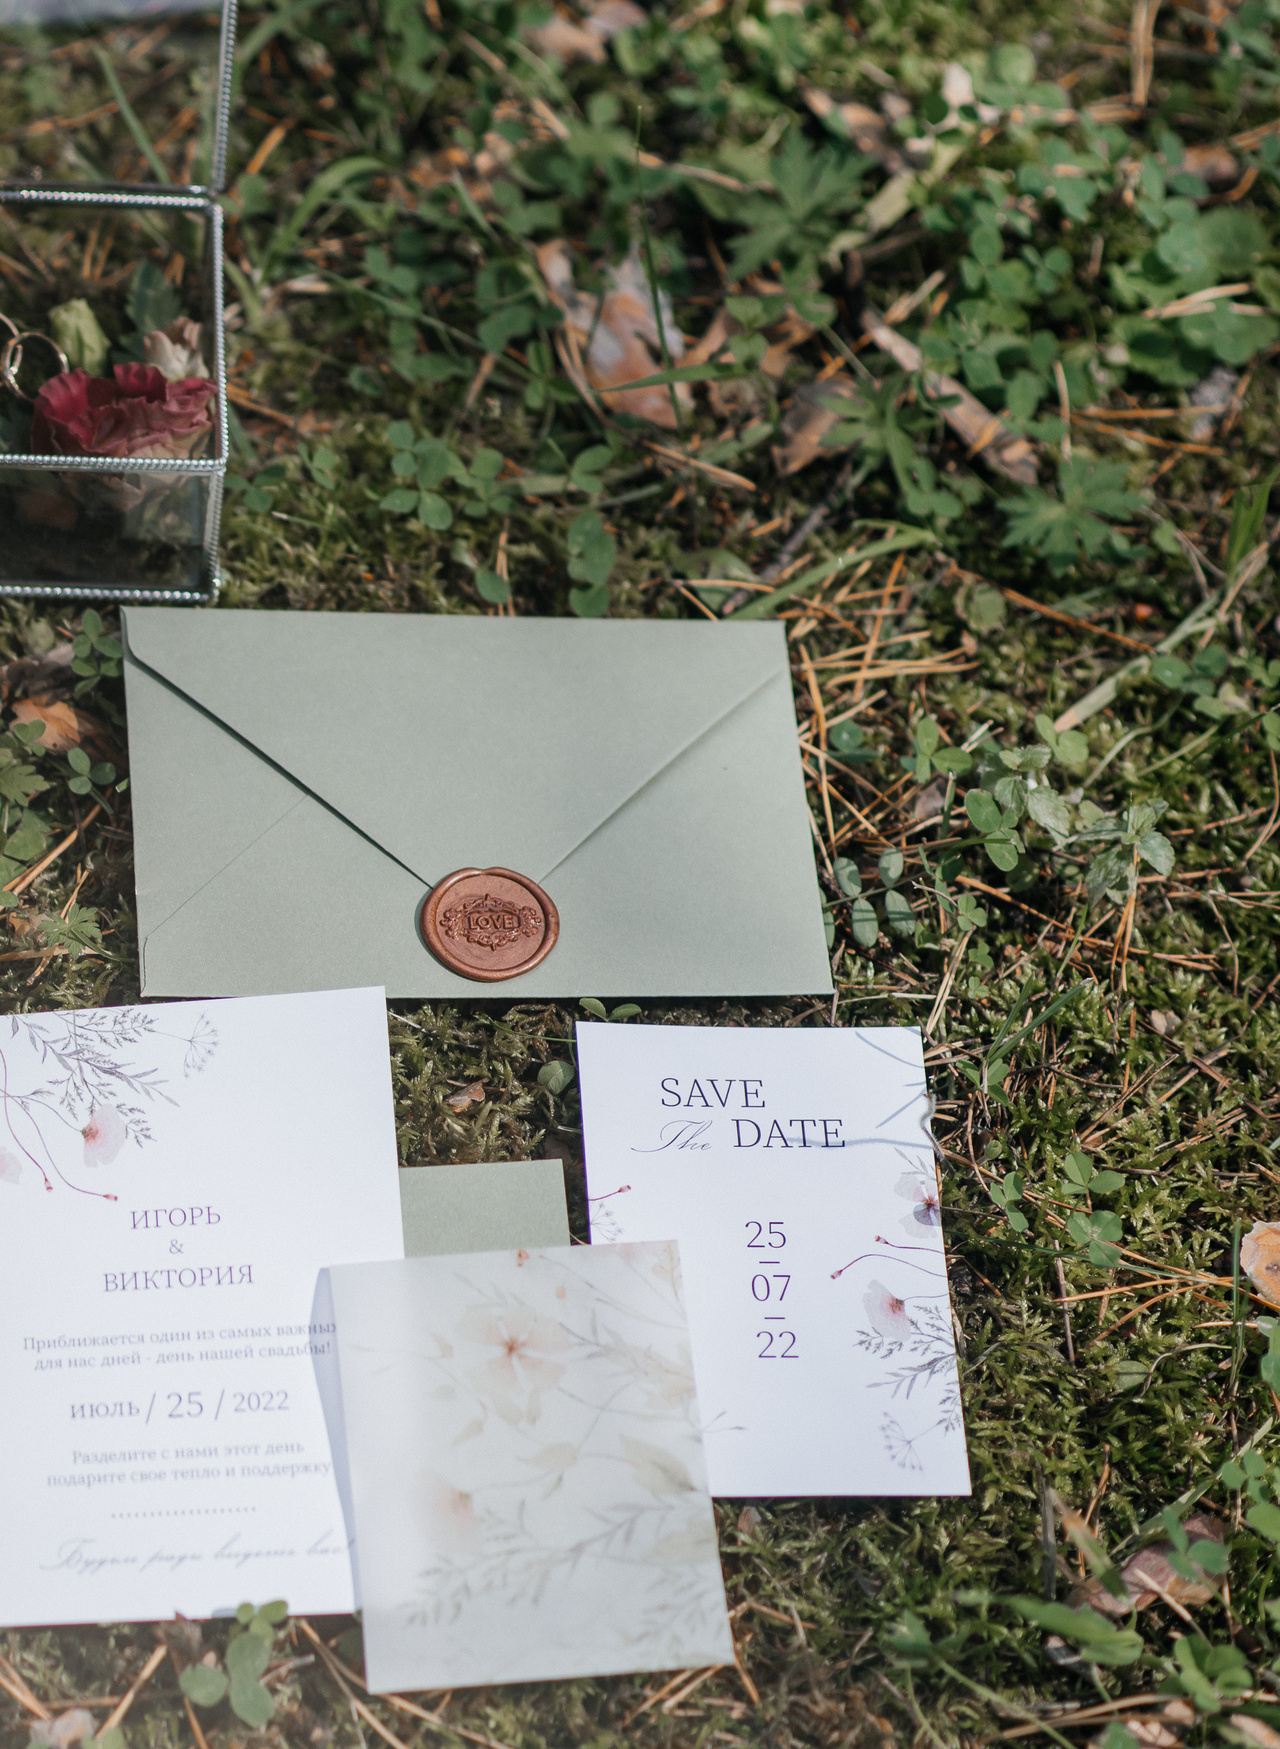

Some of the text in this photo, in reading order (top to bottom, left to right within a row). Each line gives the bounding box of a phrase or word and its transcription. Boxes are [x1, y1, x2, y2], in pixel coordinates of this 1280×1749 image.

[467, 914, 514, 930] LOVE
[660, 1077, 766, 1108] SAVE
[630, 1118, 846, 1153] The DATE
[130, 1205, 222, 1230] ИГОРЬ
[168, 1238, 184, 1255] &
[744, 1220, 788, 1249] 25
[103, 1264, 255, 1293] ВИКТОРИЯ
[751, 1273, 792, 1302] 07
[23, 1333, 145, 1353] Приближается
[149, 1329, 191, 1344] один
[196, 1328, 215, 1341] из
[218, 1325, 272, 1338] самых
[756, 1330, 800, 1359] 22
[34, 1357, 63, 1371] для
[67, 1355, 96, 1369] нас
[100, 1350, 142, 1368] дней
[155, 1349, 195, 1365] день
[198, 1343, 254, 1362] нашей
[166, 1390, 204, 1419] 25
[232, 1389, 290, 1413] 2022
[72, 1441, 305, 1466] Разделите с нами этот день
[46, 1471, 127, 1489] подарите
[130, 1469, 168, 1482] свое
[171, 1465, 221, 1481] тепло
[225, 1464, 237, 1478] и
